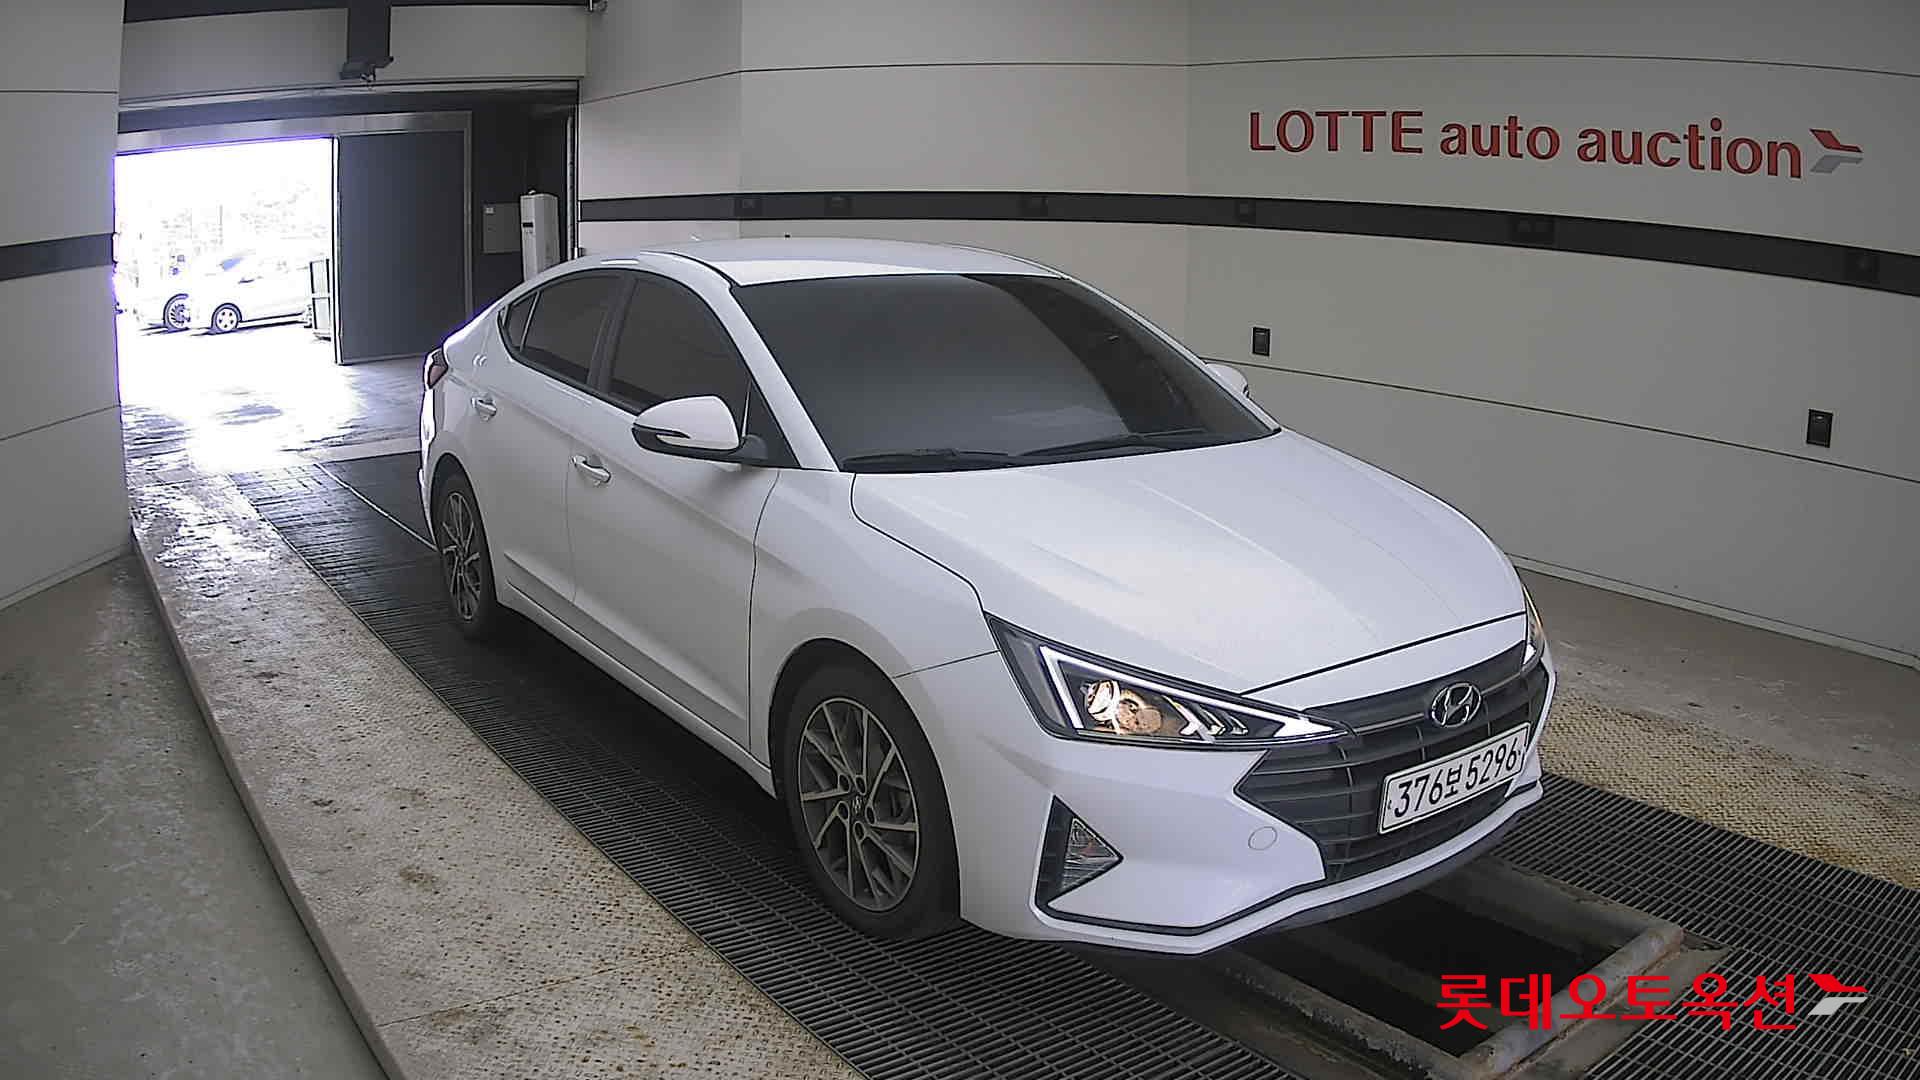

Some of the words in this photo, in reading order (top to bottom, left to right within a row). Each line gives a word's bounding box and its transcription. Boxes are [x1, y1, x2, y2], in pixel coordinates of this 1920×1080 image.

[1249, 110, 1424, 154] LOTTE
[1439, 115, 1561, 161] auto
[1576, 117, 1802, 179] auction
